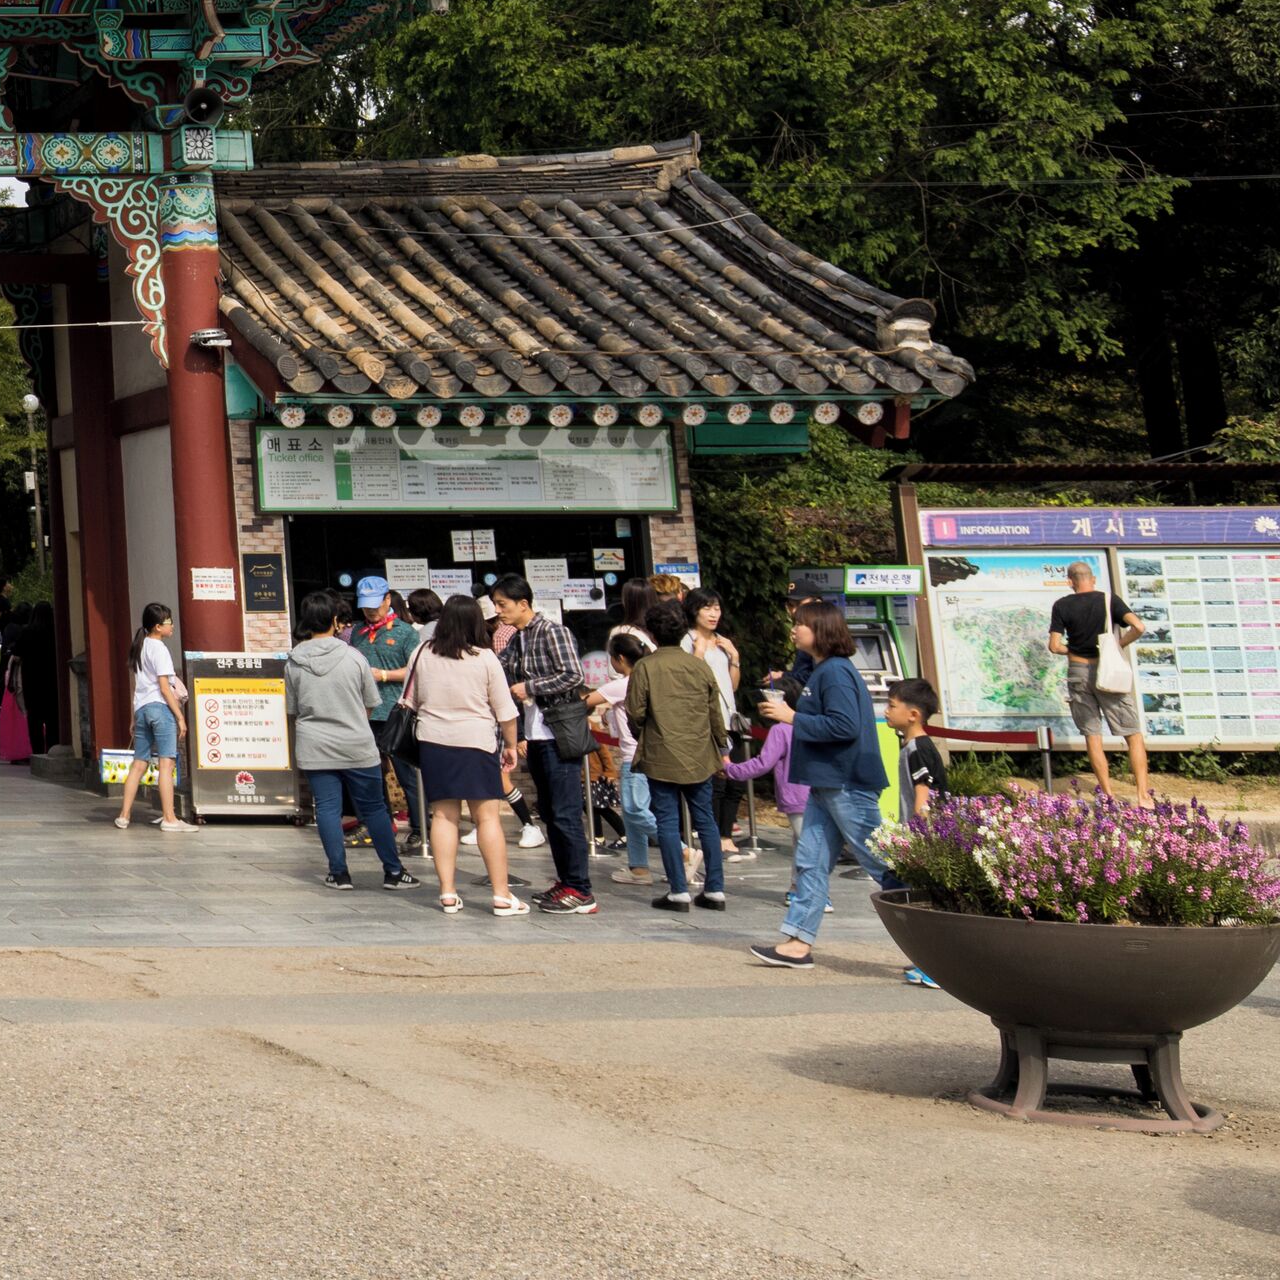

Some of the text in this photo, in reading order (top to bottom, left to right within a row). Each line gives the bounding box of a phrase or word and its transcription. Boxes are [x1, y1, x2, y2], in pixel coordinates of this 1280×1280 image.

[267, 437, 324, 452] 매표소
[268, 453, 324, 463] Ticket office
[960, 526, 1030, 535] INFORMATION
[1072, 517, 1158, 537] 게시판
[869, 574, 912, 585] 전북은행
